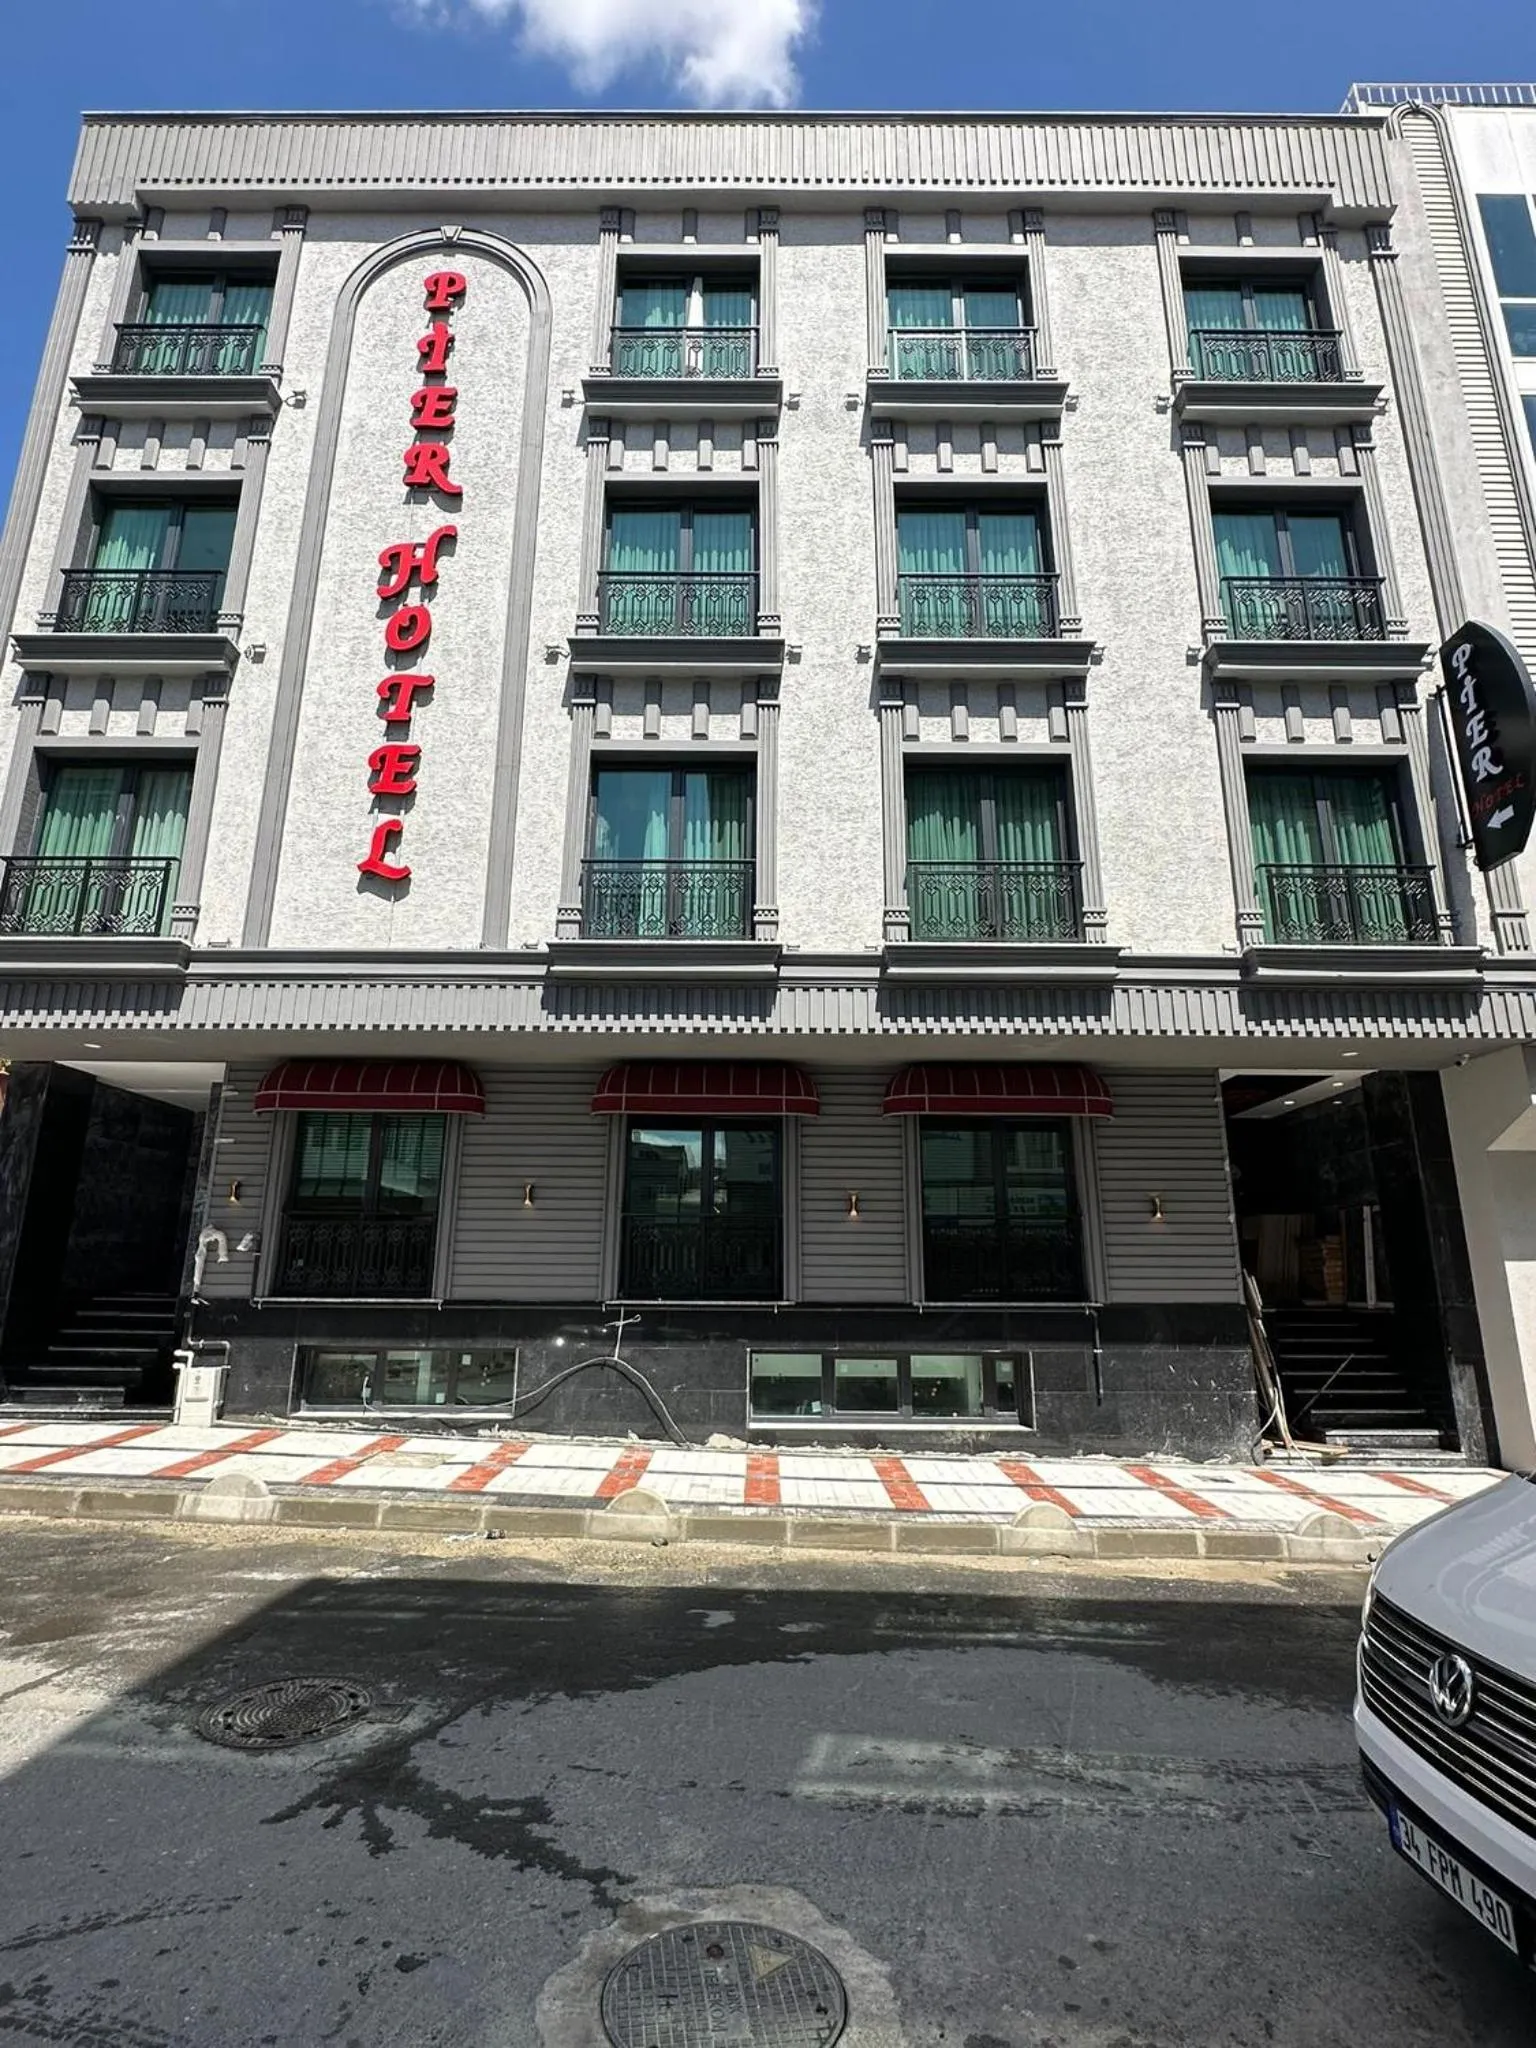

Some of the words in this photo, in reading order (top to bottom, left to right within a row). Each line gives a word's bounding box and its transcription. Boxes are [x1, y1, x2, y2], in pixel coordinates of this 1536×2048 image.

[357, 524, 458, 883] HOTEL
[1400, 1817, 1422, 1861] 34
[1427, 1839, 1464, 1900] FPM
[1471, 1878, 1512, 1942] 490
